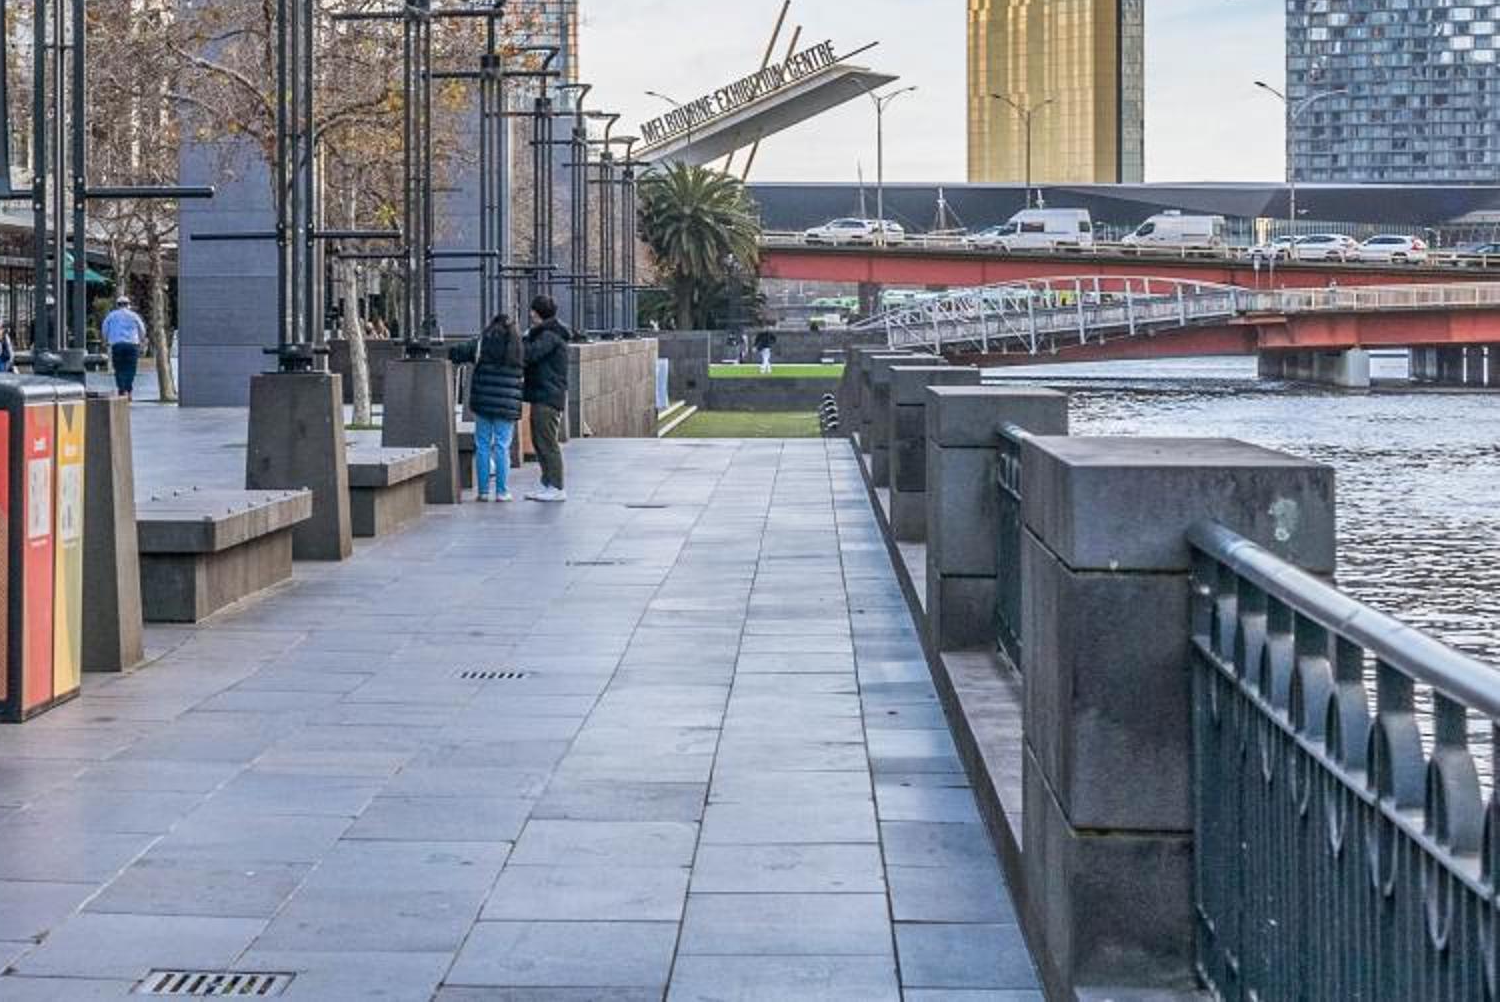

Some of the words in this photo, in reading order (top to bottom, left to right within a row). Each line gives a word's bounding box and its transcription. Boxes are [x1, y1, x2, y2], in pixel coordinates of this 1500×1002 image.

[639, 95, 716, 145] MELBOURNE
[713, 63, 785, 112] EXHIBITION
[785, 39, 837, 79] CENTRE
